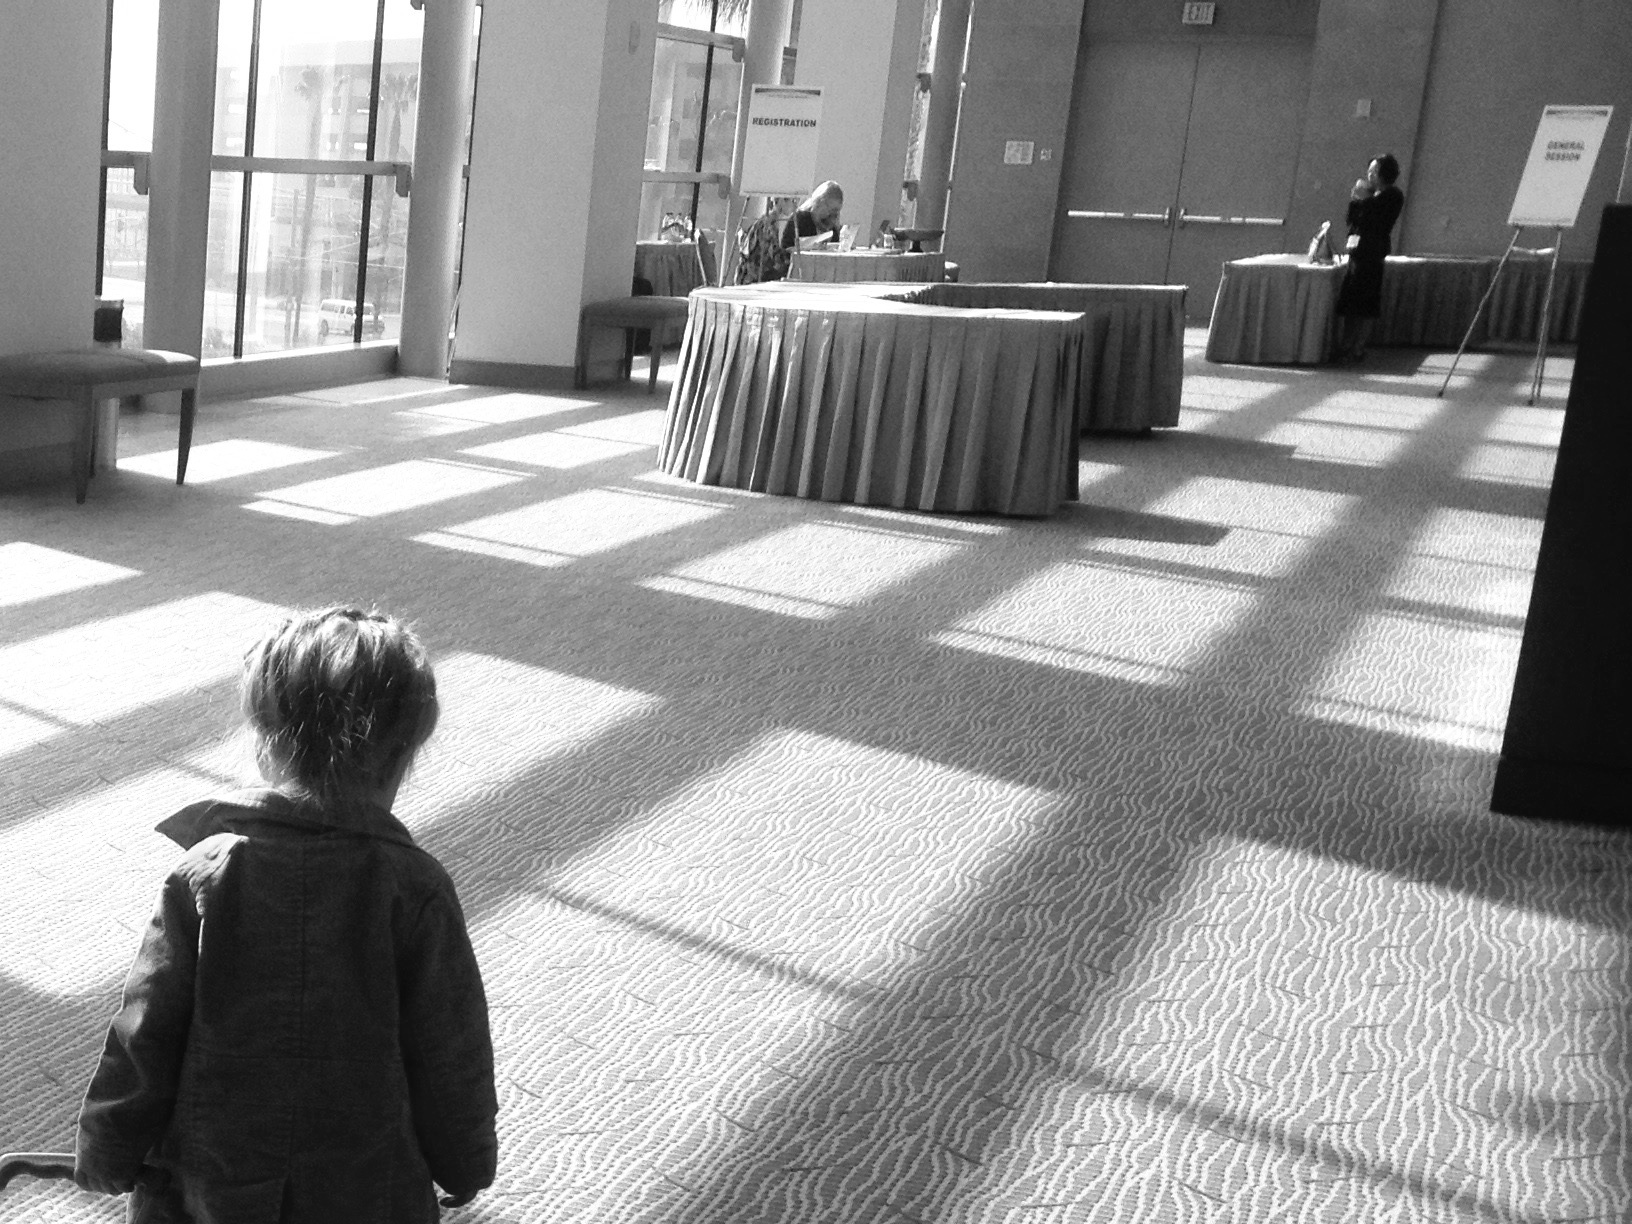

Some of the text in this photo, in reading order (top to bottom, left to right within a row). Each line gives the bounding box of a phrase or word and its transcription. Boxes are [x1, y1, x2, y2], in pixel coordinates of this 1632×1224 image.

[752, 117, 817, 127] REGISTRATION
[1548, 140, 1585, 150] GENERAL
[1545, 151, 1581, 161] SESSION
